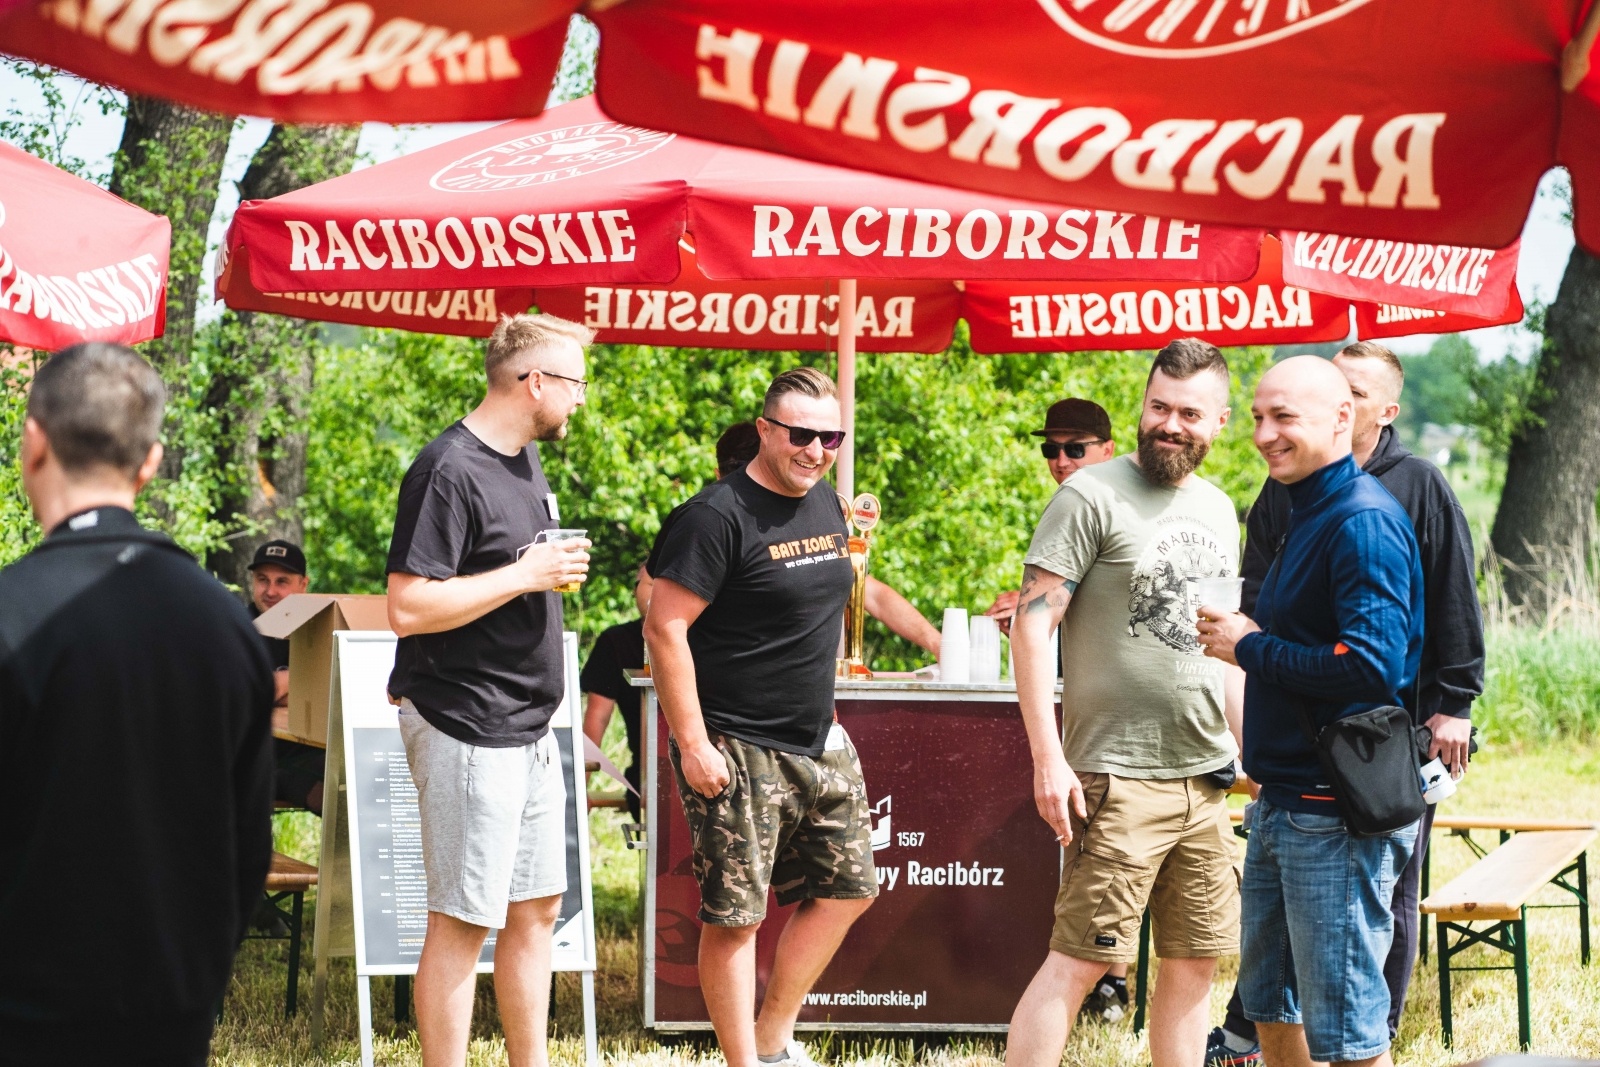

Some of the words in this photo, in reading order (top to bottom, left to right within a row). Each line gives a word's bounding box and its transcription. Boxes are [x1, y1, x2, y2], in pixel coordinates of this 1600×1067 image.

[285, 209, 636, 271] RACIBORSKIE
[752, 204, 1202, 260] RACIBORSKIE
[1293, 230, 1496, 297] RACIBORSKIE
[768, 540, 802, 561] BAIT
[813, 554, 824, 565] you
[896, 831, 926, 847] 1567
[907, 860, 1005, 886] Racibórz
